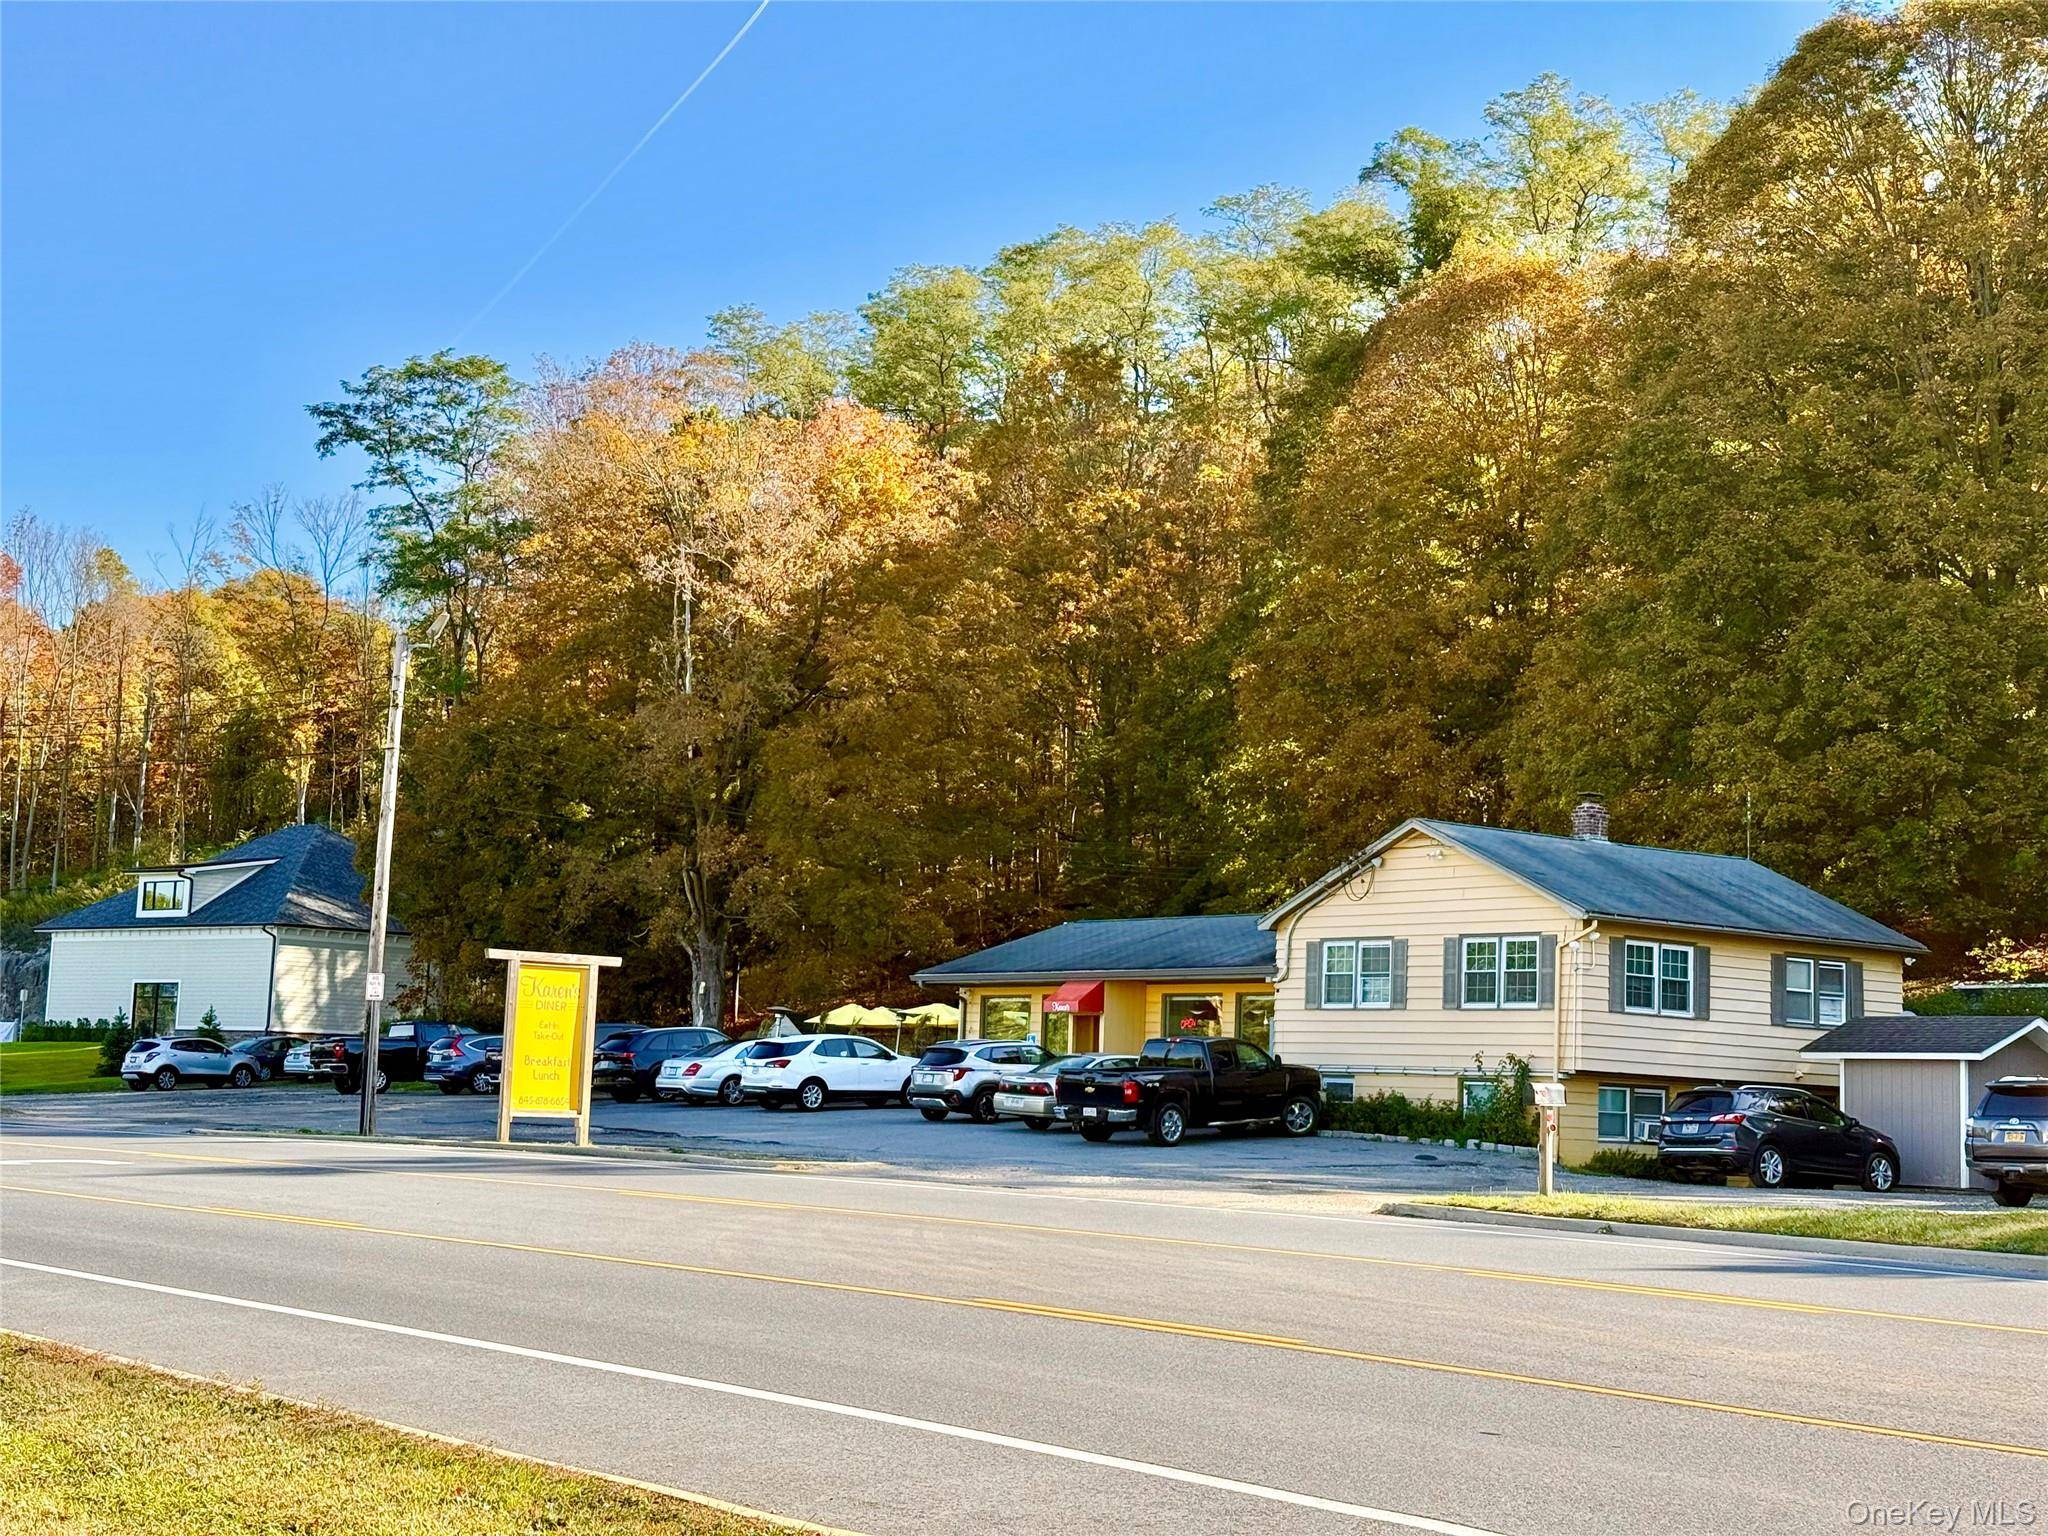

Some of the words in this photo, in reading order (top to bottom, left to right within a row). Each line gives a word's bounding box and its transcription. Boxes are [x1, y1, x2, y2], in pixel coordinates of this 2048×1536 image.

[520, 975, 579, 1000] Karen's
[535, 999, 568, 1012] DINER
[532, 1069, 561, 1081] Lunch
